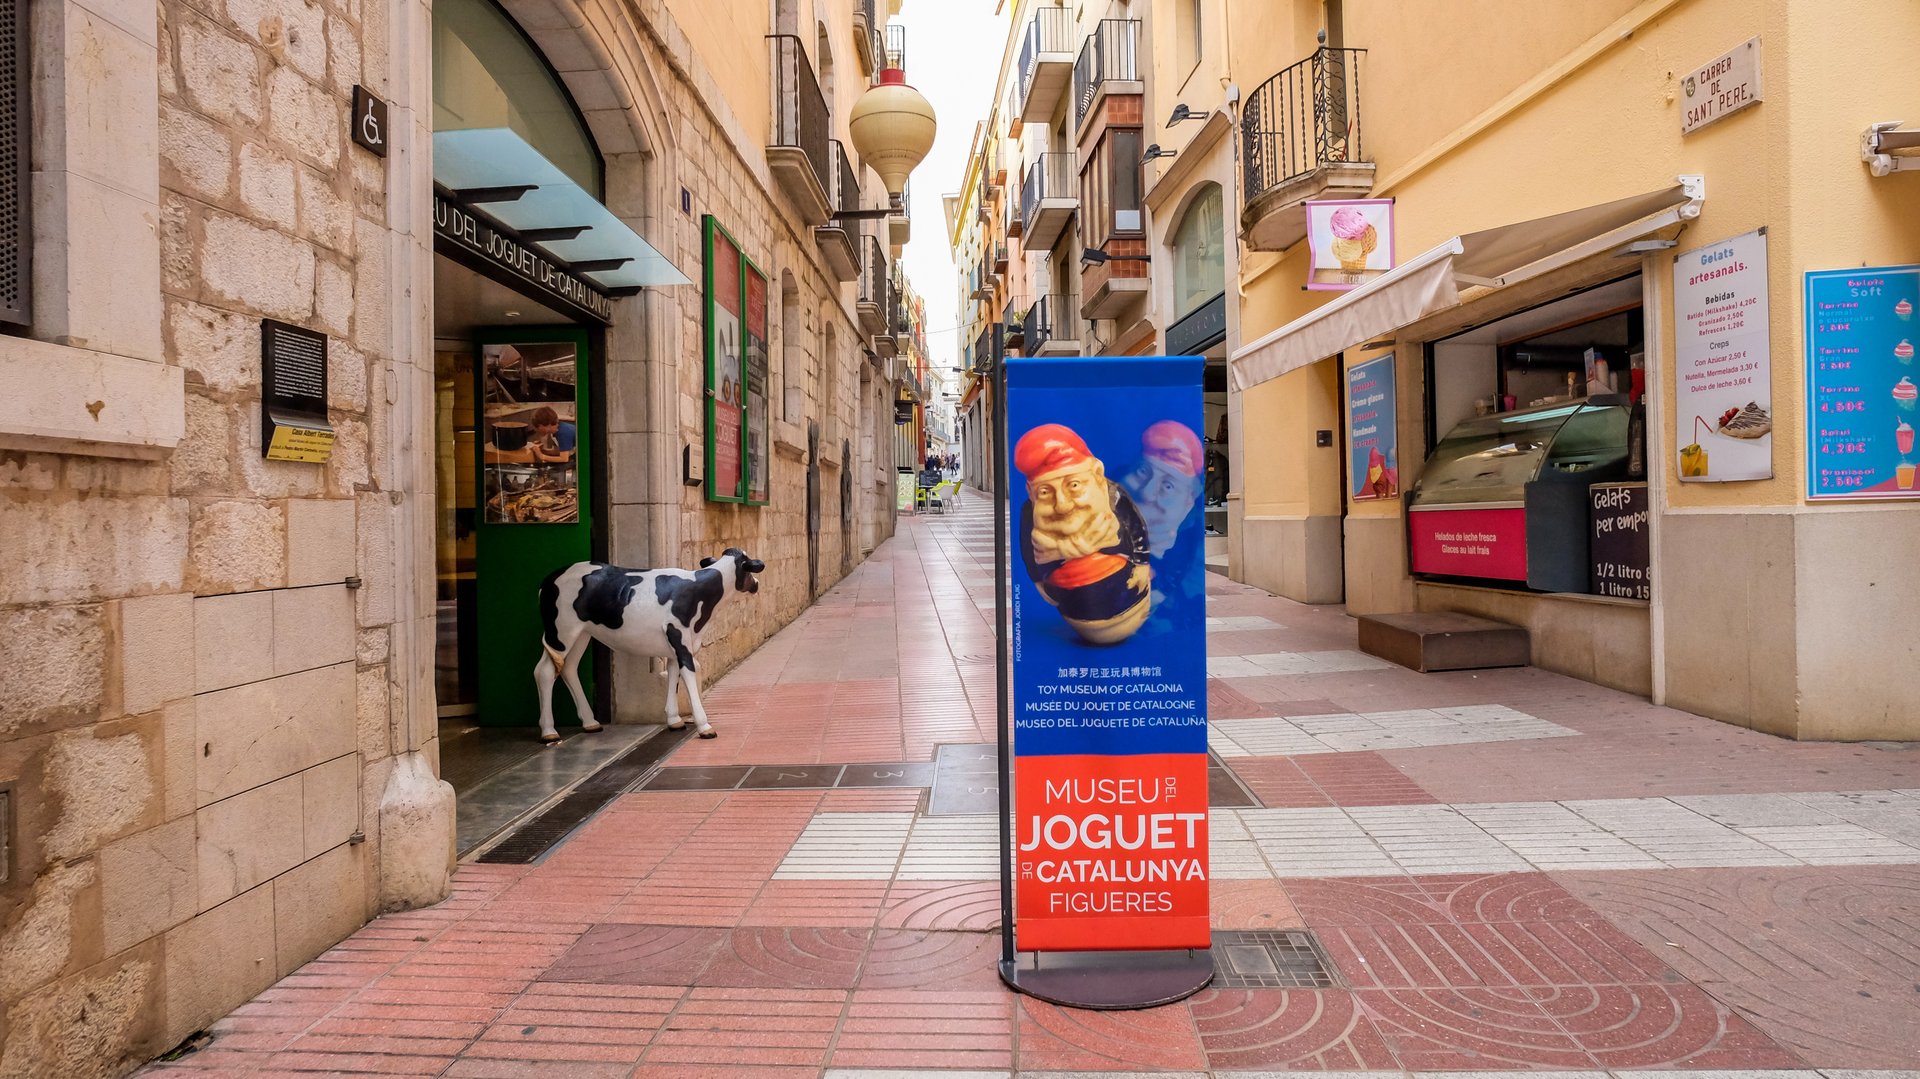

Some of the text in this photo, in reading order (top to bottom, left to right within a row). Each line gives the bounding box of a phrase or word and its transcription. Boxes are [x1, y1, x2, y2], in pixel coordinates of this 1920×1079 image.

[1701, 57, 1731, 84] CARRER
[1711, 79, 1721, 95] DE
[1687, 83, 1747, 127] SANT PERE
[453, 207, 481, 248] DEL
[486, 229, 537, 277] JOGUET
[541, 259, 555, 288] DE
[558, 271, 611, 318] CATALUNYA
[1701, 248, 1734, 265] Gelats
[1689, 261, 1748, 285] artesanals.
[1705, 291, 1735, 305] Bebidas
[1851, 286, 1881, 297] Soft
[1687, 311, 1703, 320] Batido
[1705, 302, 1738, 316] (Milkshake)
[1698, 316, 1725, 327] Granizado
[1699, 325, 1726, 336] Refrescos
[1709, 340, 1729, 350] Creps
[1694, 359, 1706, 367] Con
[1707, 366, 1738, 377] Mermelada
[1708, 382, 1715, 390] de
[1717, 380, 1732, 389] leche
[1594, 488, 1631, 509] Gelats
[1596, 516, 1614, 538] per
[1434, 532, 1497, 542] Helados de leche fresca
[1442, 544, 1490, 555] Glaces au lait frais
[1597, 562, 1614, 578] 1/2
[1618, 564, 1642, 579] litro
[1600, 581, 1605, 595] 1
[1609, 582, 1632, 597] litro
[1058, 666, 1162, 678] 加泰罗尼亚玩具博物馆
[1037, 683, 1183, 695] TOY MUSEUM OF CATALONIA
[1025, 700, 1196, 712] MUSÉE DU JOUET DE CATALOGNE
[1016, 714, 1207, 729] MUSEO DEL JUGUETE DE CATALUÑA
[1046, 777, 1177, 804] MUSEU DEL
[1020, 813, 1205, 851] JOGUET
[1022, 859, 1206, 883] DE CATALUNYA
[1050, 891, 1173, 913] FIGUERES
